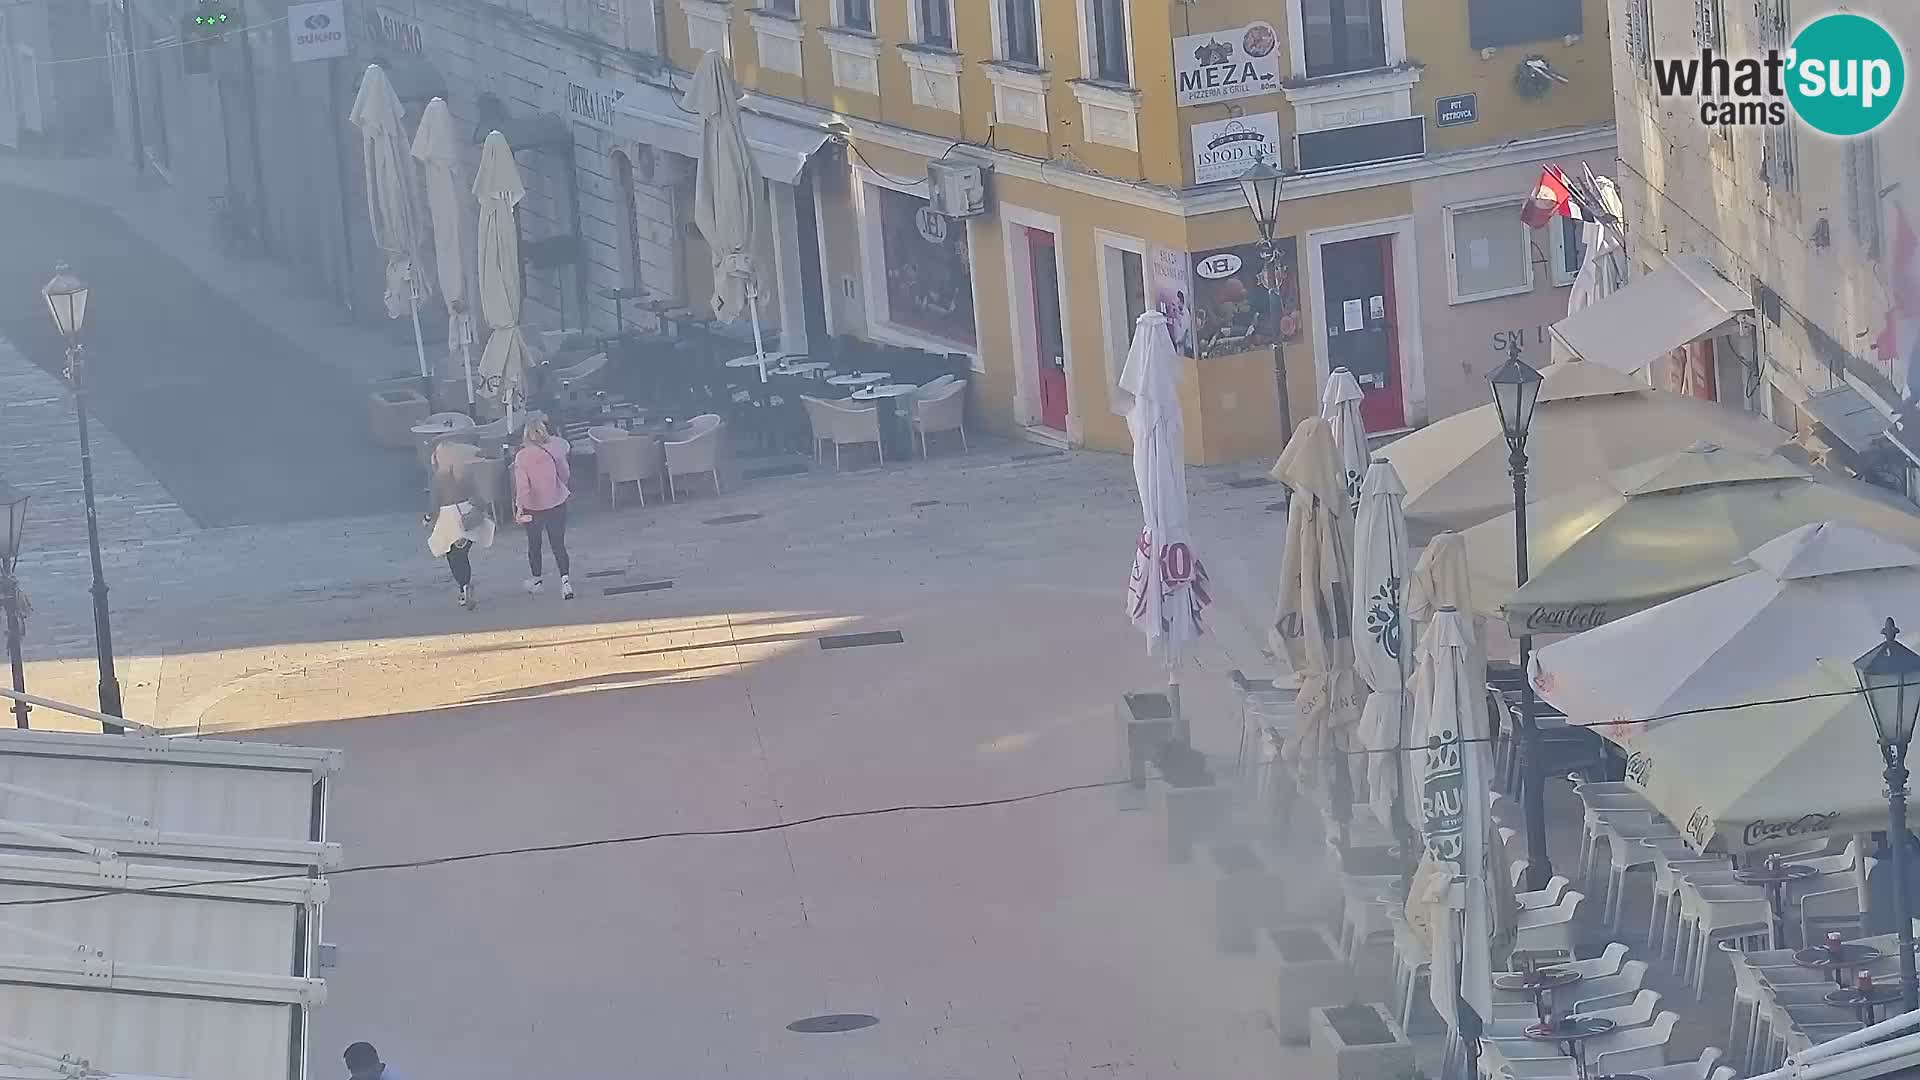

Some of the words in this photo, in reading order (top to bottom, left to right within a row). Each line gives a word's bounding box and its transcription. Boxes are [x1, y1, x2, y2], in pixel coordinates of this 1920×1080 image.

[1180, 61, 1258, 92] MEZA
[1189, 87, 1221, 100] PIZZERIA
[1230, 84, 1250, 94] GRILL
[1199, 147, 1243, 165] ISPOD
[1249, 142, 1276, 157] URE
